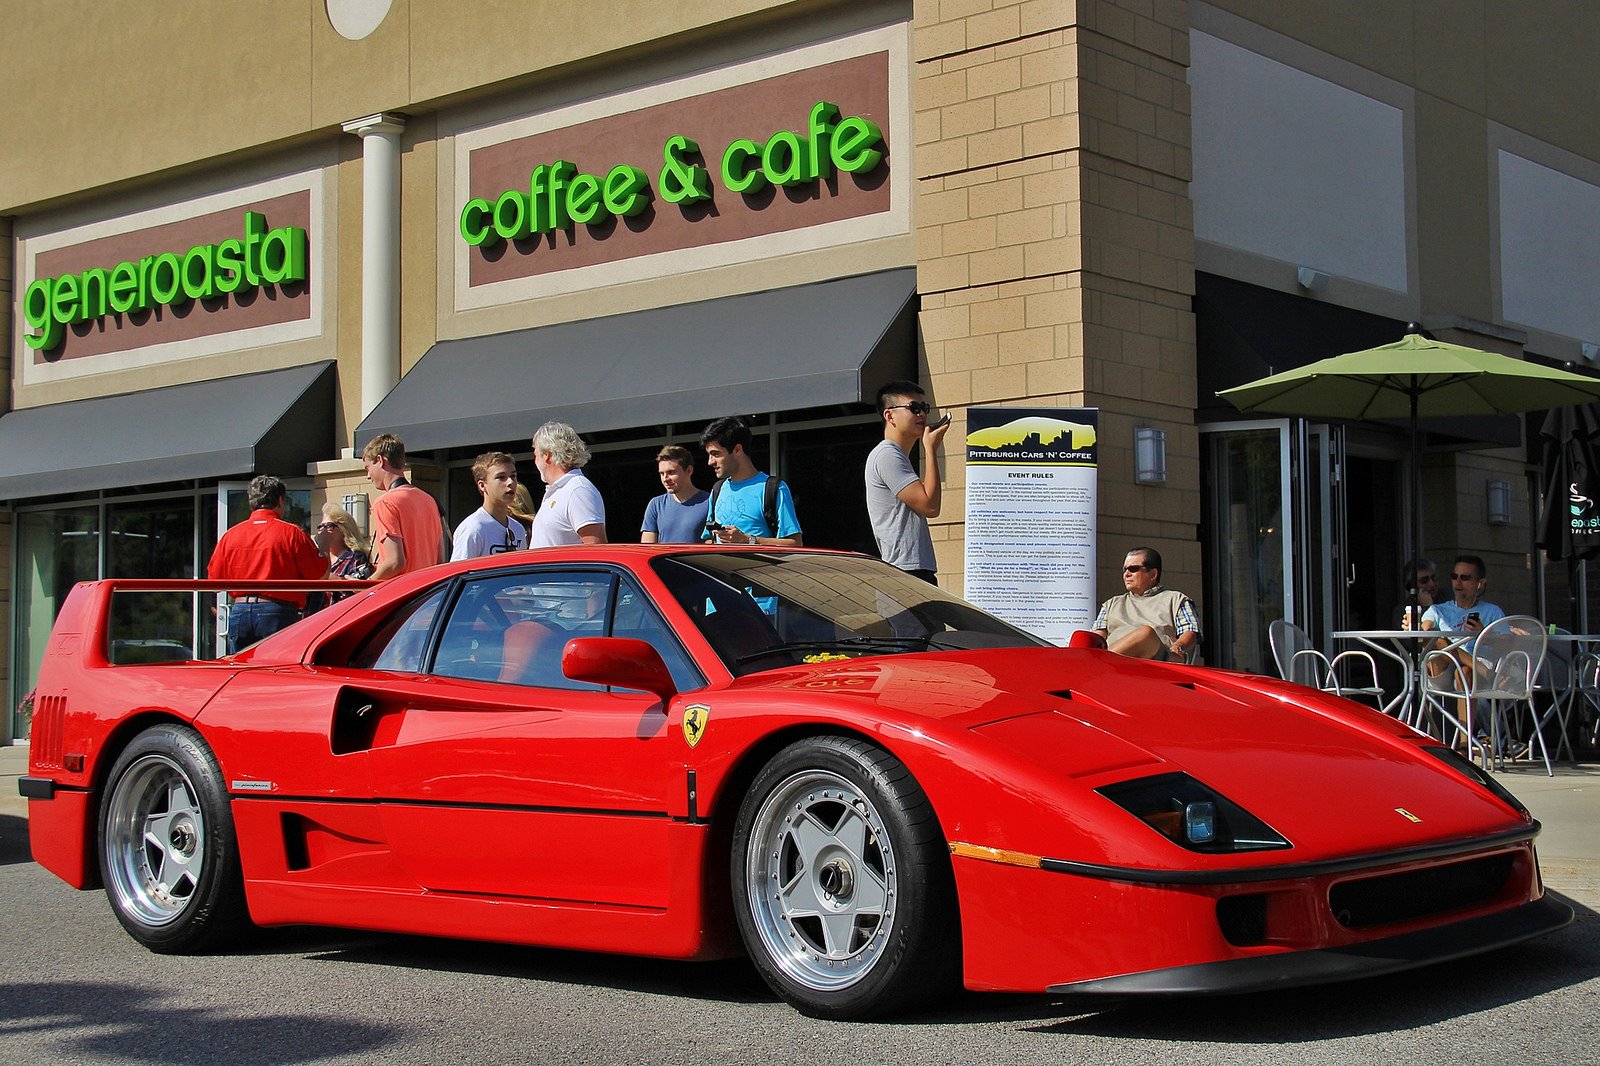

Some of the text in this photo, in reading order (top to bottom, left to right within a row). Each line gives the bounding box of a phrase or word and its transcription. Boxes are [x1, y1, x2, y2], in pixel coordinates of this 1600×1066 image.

[460, 101, 883, 247] coffee & cafe
[24, 211, 305, 350] generoasta
[1021, 451, 1044, 459] CARS
[1059, 451, 1092, 460] COFFEE
